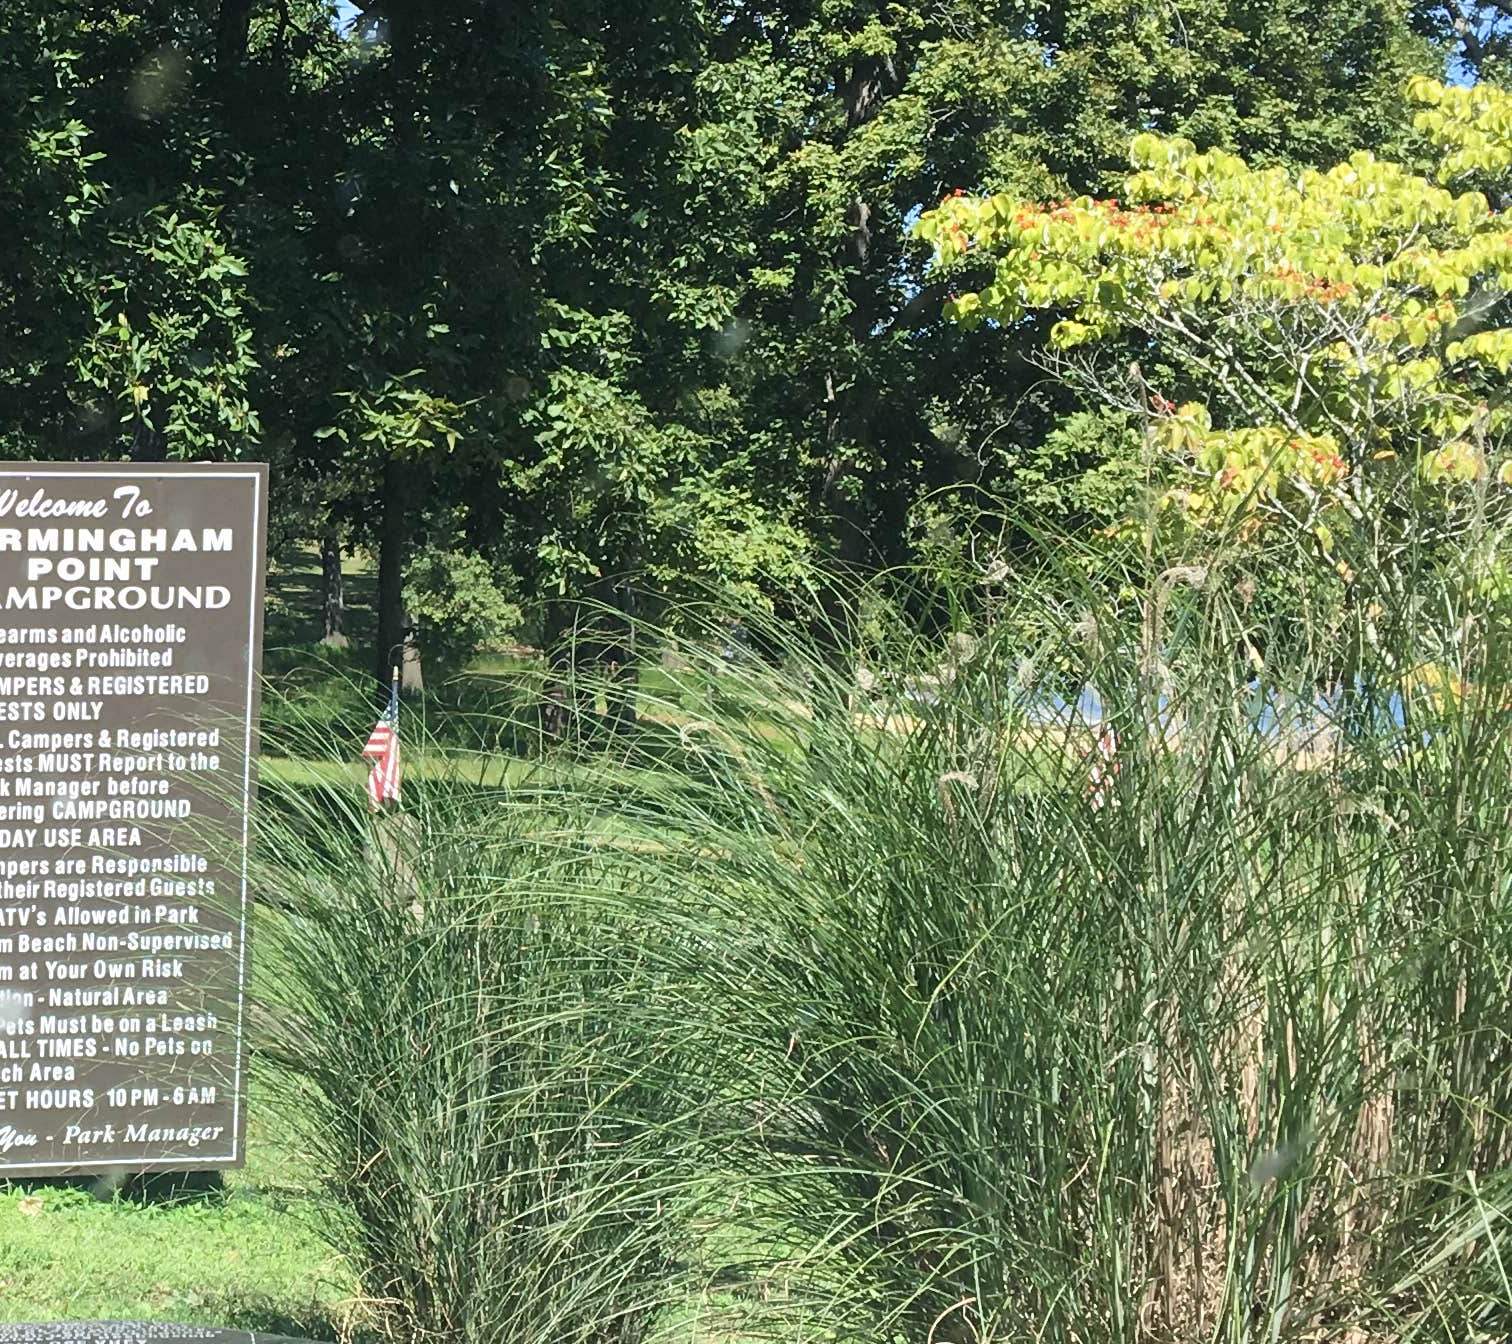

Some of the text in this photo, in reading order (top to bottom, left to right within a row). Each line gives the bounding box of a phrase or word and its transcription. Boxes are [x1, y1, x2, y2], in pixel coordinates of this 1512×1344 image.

[114, 486, 153, 518] To
[27, 558, 158, 581] POINT
[62, 625, 96, 644] and
[100, 625, 186, 643] Alcoholic
[76, 648, 172, 667] Prohibited
[70, 677, 83, 695] &
[88, 675, 209, 695] REGISTERED
[53, 702, 104, 720] ONLY
[8, 730, 93, 752] Campers
[99, 730, 111, 748] &
[117, 728, 219, 750] Registered
[39, 754, 93, 772] MUST
[99, 754, 163, 775] Report
[168, 754, 186, 770] to
[190, 754, 219, 770] the
[16, 778, 102, 800] Manager
[107, 777, 169, 795] before
[52, 800, 191, 820] CAMPGROUND
[0, 830, 36, 847] DAY
[44, 829, 81, 847] USE
[88, 828, 141, 847] AREA
[55, 860, 86, 875] are
[92, 855, 207, 877] Responsible
[44, 879, 145, 902] Registered
[150, 878, 215, 897] Guests
[54, 907, 129, 925] Allowed
[134, 906, 150, 924] in
[156, 905, 199, 924] Park
[18, 934, 77, 953] Beach
[82, 932, 232, 954] Non-Supervised
[19, 961, 38, 980] at
[46, 960, 88, 980] Your
[94, 960, 135, 979] Own
[142, 959, 184, 978] Risk
[49, 988, 119, 1007] Natural
[122, 987, 167, 1005] Area
[40, 1015, 88, 1034] Must
[92, 1015, 114, 1034] be
[119, 1017, 140, 1032] on
[146, 1017, 157, 1032] a
[161, 1012, 217, 1032] Leash
[37, 1038, 97, 1058] TIMES
[115, 1037, 139, 1057] No
[145, 1036, 185, 1055] Pets
[191, 1038, 212, 1055] on
[30, 1062, 75, 1082] Area
[26, 1089, 94, 1110] HOURS
[63, 1127, 114, 1145] Park
[123, 1125, 224, 1146] Manager
